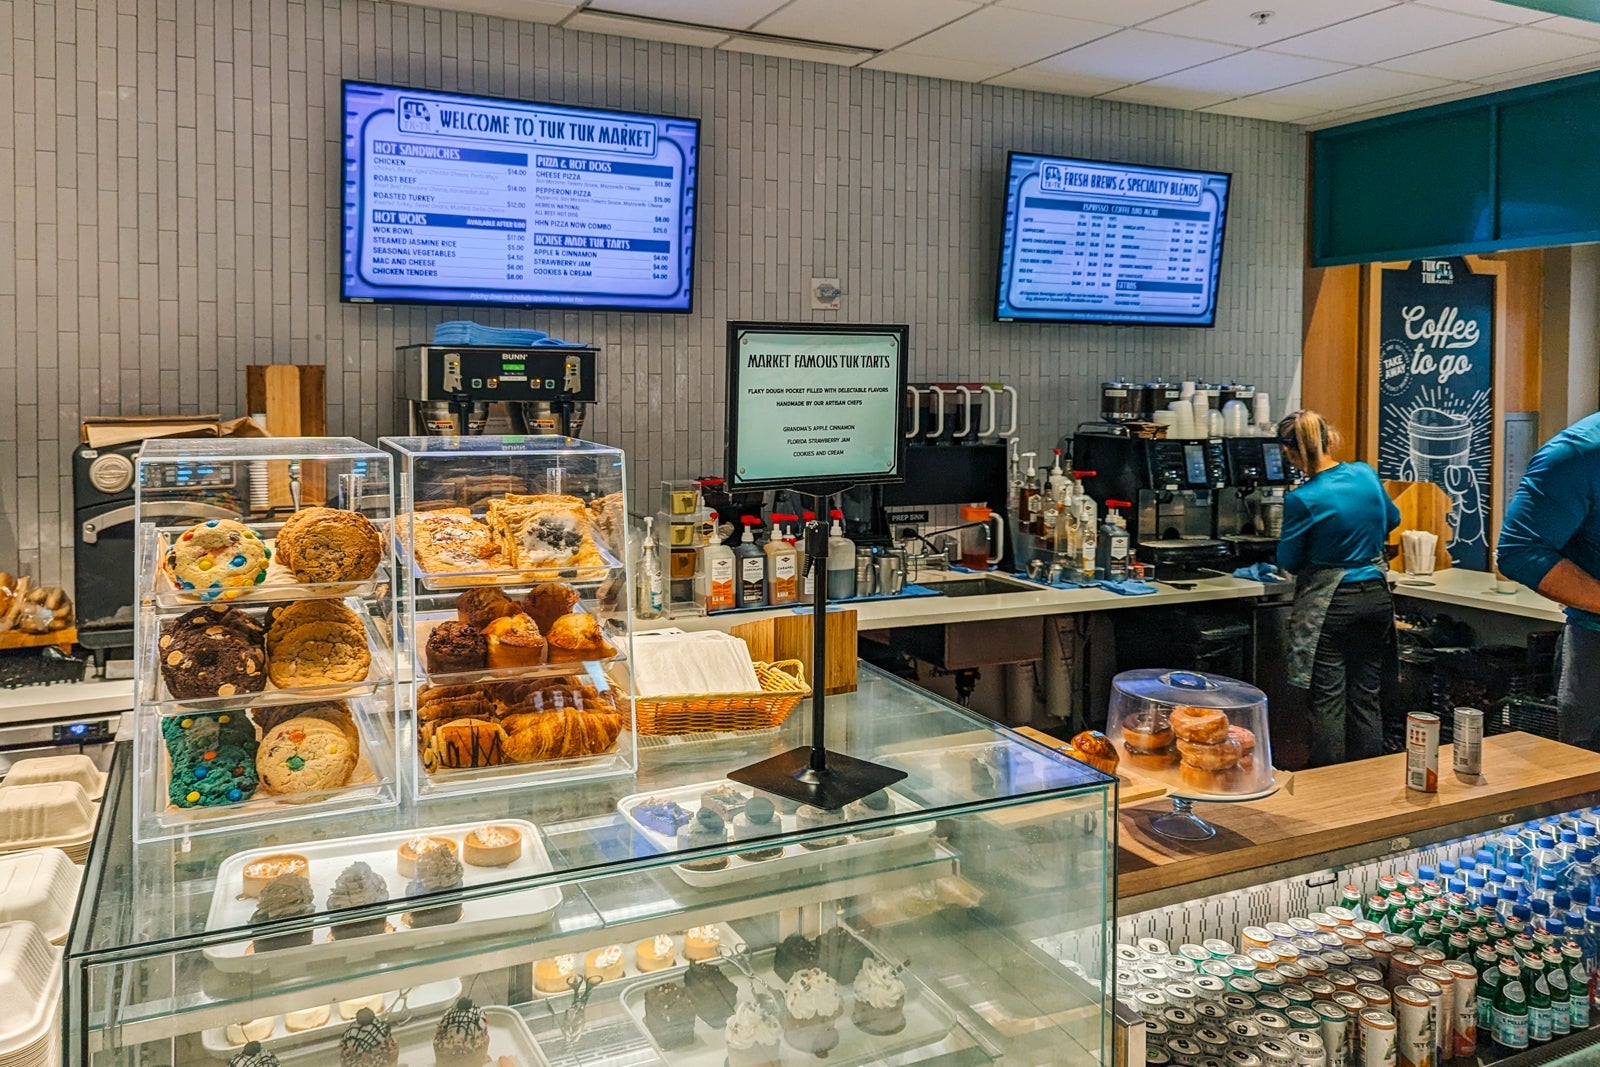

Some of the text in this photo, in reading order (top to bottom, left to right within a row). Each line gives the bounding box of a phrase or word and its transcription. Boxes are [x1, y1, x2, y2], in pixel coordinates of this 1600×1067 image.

[440, 110, 651, 148] WELCOME TO TUK TUK MARKET
[375, 141, 460, 160] HOT SANDWICHES
[374, 158, 406, 166] CHICKEN
[538, 156, 612, 172] PIZZA & HOT DOGS
[507, 168, 526, 176] $14.00
[536, 170, 560, 178] CHEESE
[374, 174, 397, 183] ROAST
[507, 184, 526, 192] $14.00
[1064, 172, 1198, 197] FRESH BREWS & SPECIALTY BLENDS
[374, 192, 435, 202] ROASTED TURKEY
[536, 187, 572, 196] PEPPERONI
[374, 211, 396, 223] HOT
[398, 212, 427, 225] WOKS
[467, 218, 495, 226] AVAILABLE
[588, 222, 612, 230] COMBO
[373, 236, 456, 248] STEAMED JASMINE RICE
[536, 234, 630, 250] HOUSE MADE TUK TARTS
[373, 247, 456, 258] SEASONAL VEGETABLES
[534, 248, 554, 256] APPLE
[562, 250, 597, 258] CINNAMON
[534, 258, 576, 266] STRAWBERRY
[1422, 260, 1436, 272] TUK
[372, 268, 438, 277] CHICKEN TENDERS
[534, 268, 562, 276] COOKIES
[1422, 272, 1436, 284] TUK
[1117, 281, 1136, 290] EXTRAS
[1402, 305, 1480, 348] Coffee
[748, 354, 890, 368] MARKET FAMOUS TUK TARTS
[1384, 354, 1403, 368] TAKE
[1410, 343, 1438, 374] to
[1438, 354, 1472, 384] go
[1386, 364, 1406, 380] AWAY
[892, 513, 925, 522] PREP SINK
